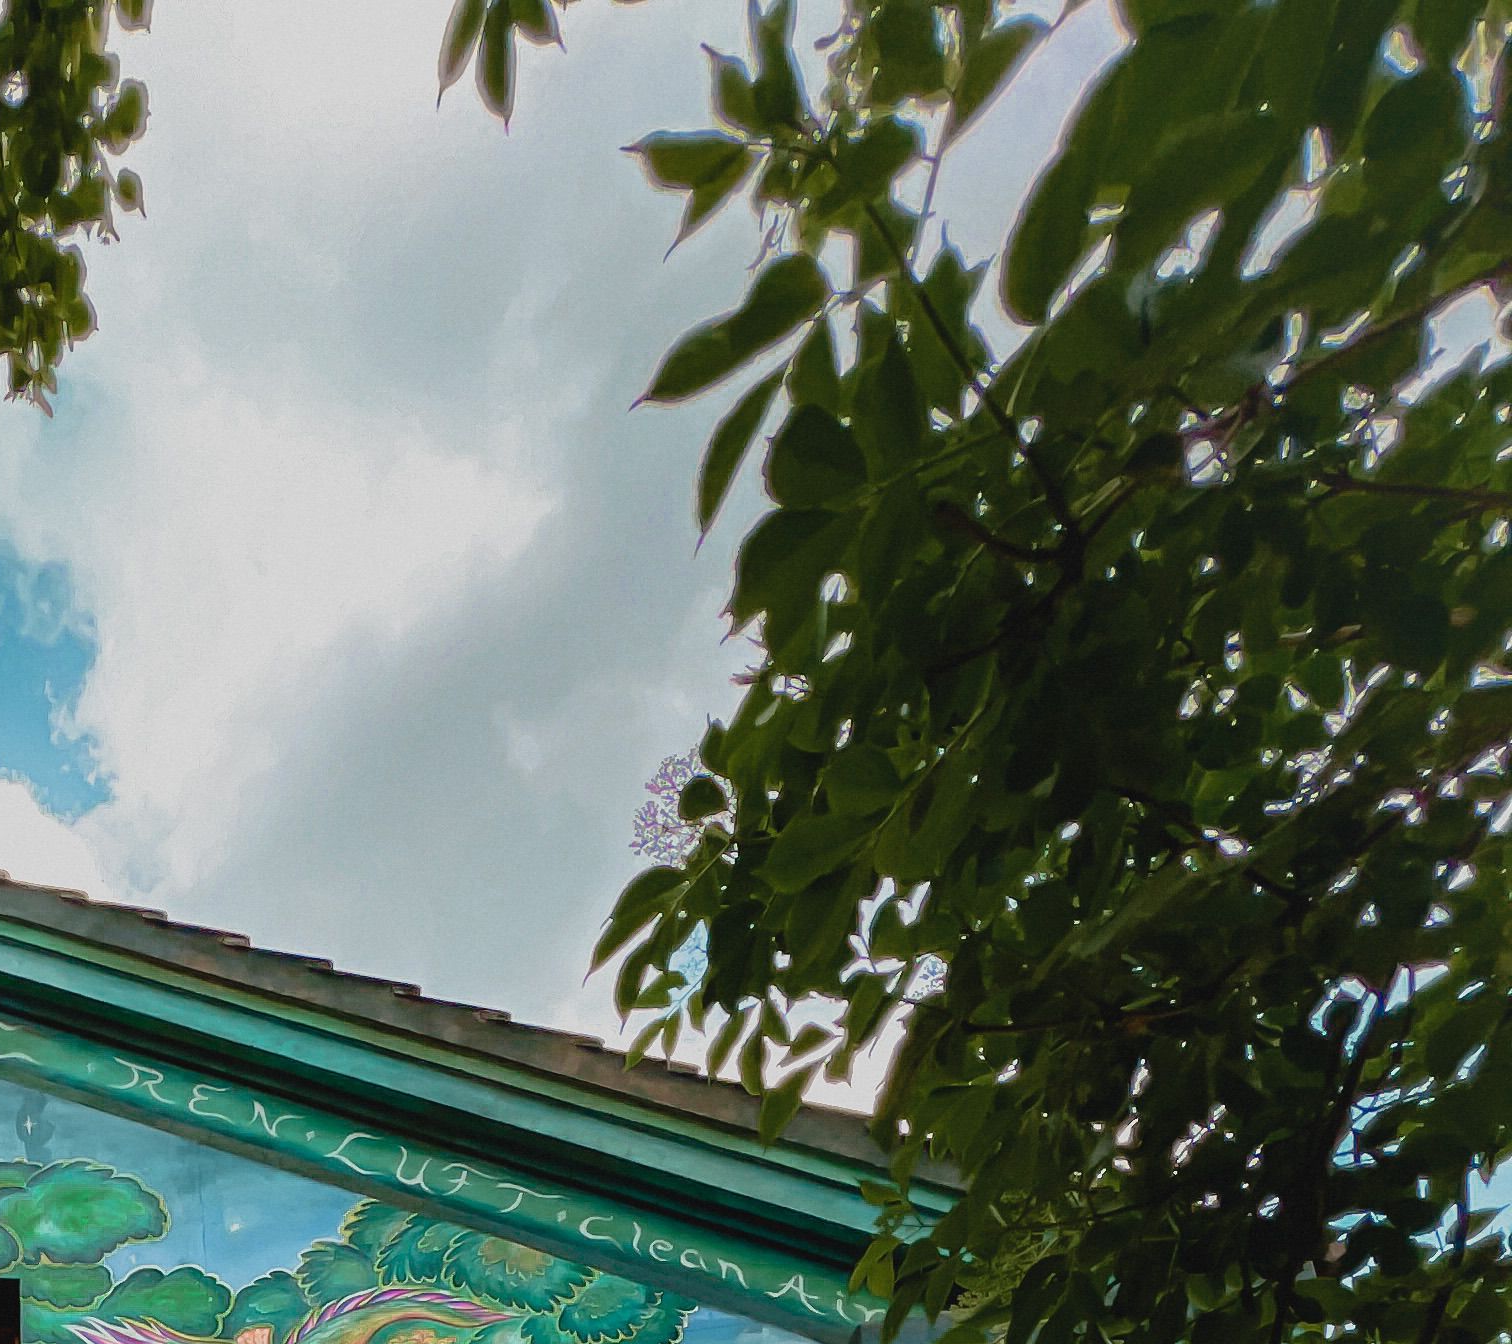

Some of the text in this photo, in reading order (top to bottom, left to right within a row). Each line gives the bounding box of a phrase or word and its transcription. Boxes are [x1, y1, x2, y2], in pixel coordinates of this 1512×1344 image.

[108, 1055, 567, 1214] REN LUFT
[578, 1215, 750, 1290] Clean
